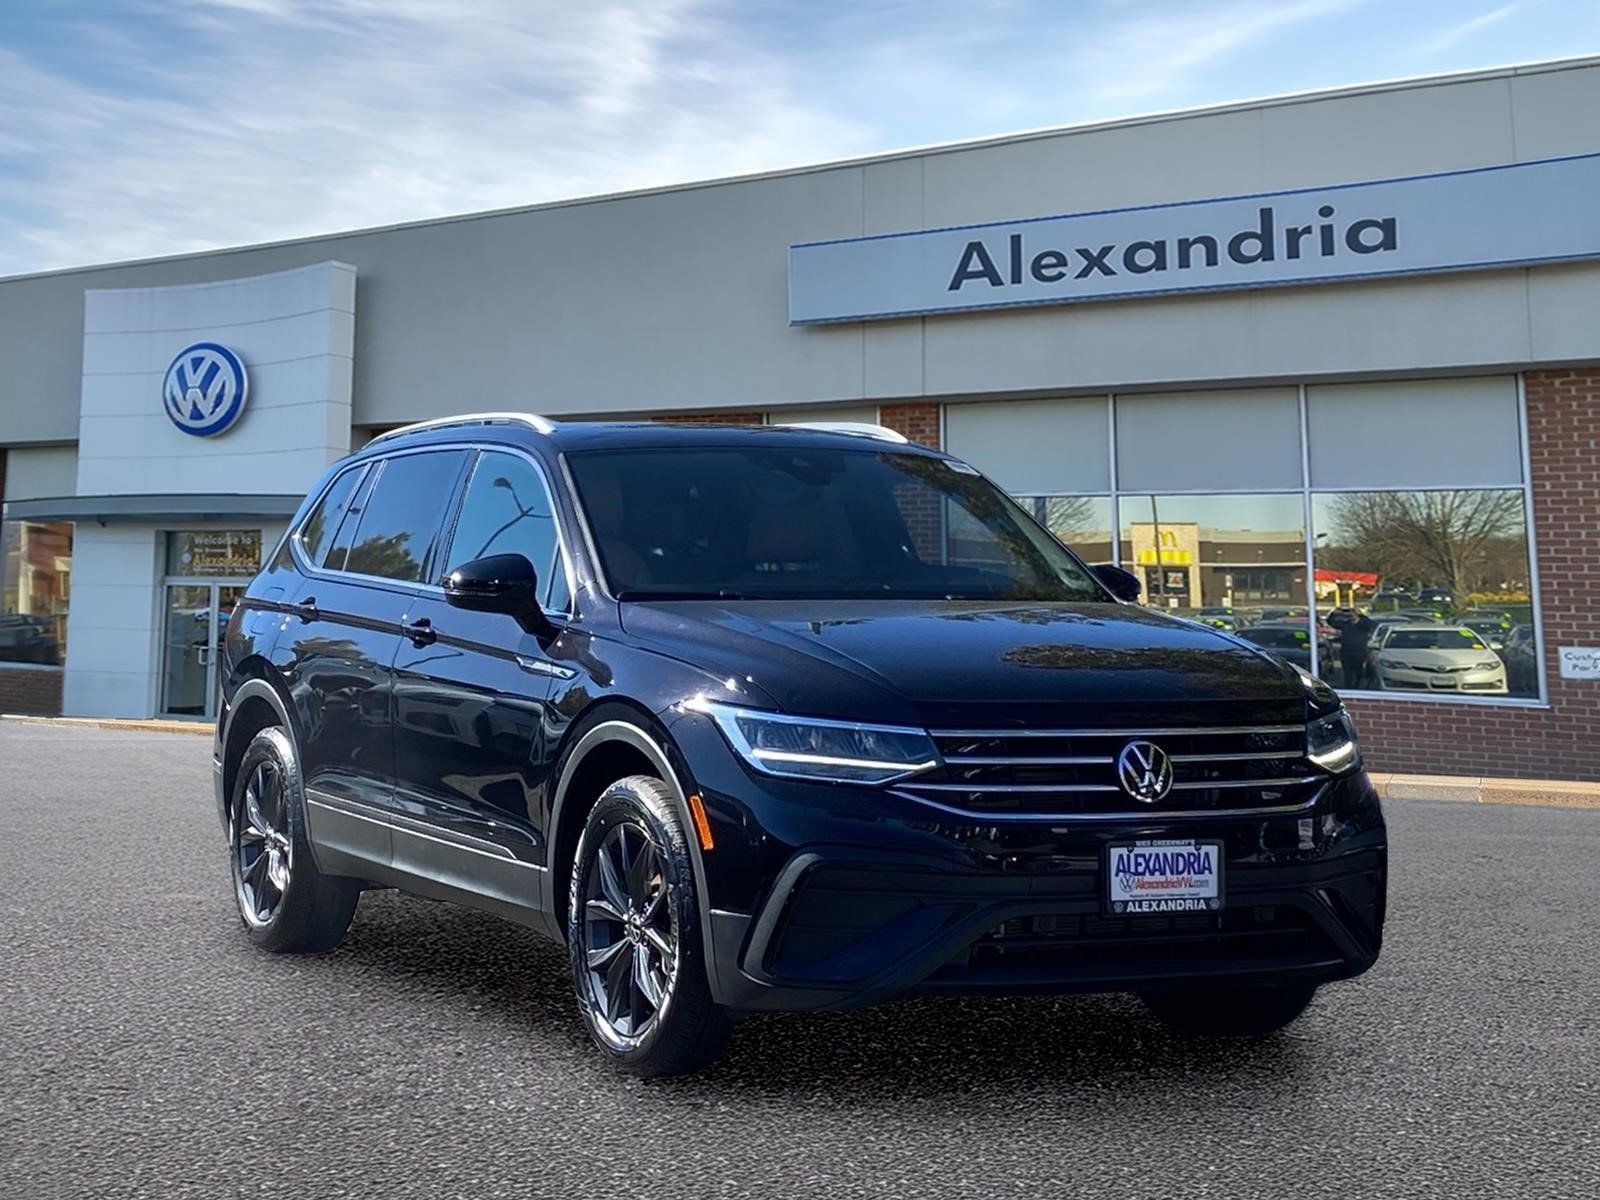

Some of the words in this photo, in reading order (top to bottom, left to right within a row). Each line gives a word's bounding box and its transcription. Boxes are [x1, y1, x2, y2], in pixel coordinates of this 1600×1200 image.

[946, 204, 1400, 292] Alexandria
[164, 347, 238, 429] VW
[194, 534, 238, 545] Welcome
[240, 535, 252, 545] to
[1114, 851, 1213, 877] ALEXANDRIA
[1126, 899, 1208, 913] ALEXANDRIA
